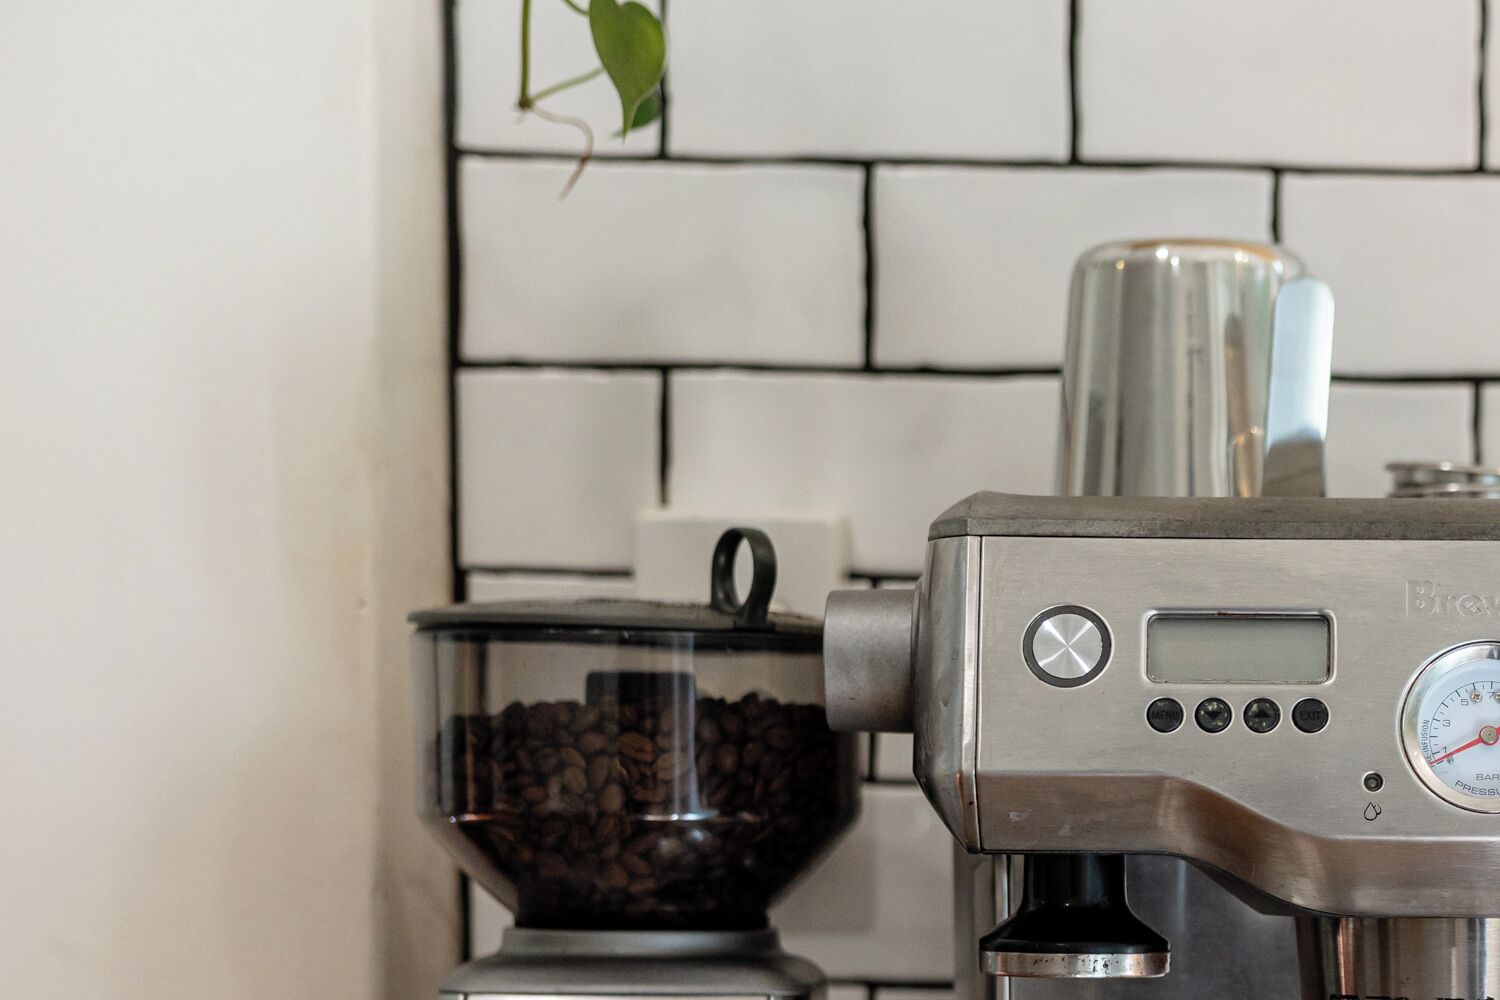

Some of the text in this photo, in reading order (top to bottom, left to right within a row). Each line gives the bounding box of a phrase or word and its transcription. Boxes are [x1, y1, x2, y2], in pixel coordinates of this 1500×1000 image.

[1487, 691, 1495, 699] 7
[1460, 698, 1469, 706] 5
[1151, 710, 1181, 720] MENU
[1300, 710, 1322, 720] EXIT
[1442, 719, 1451, 727] 3
[1475, 773, 1500, 781] BAR
